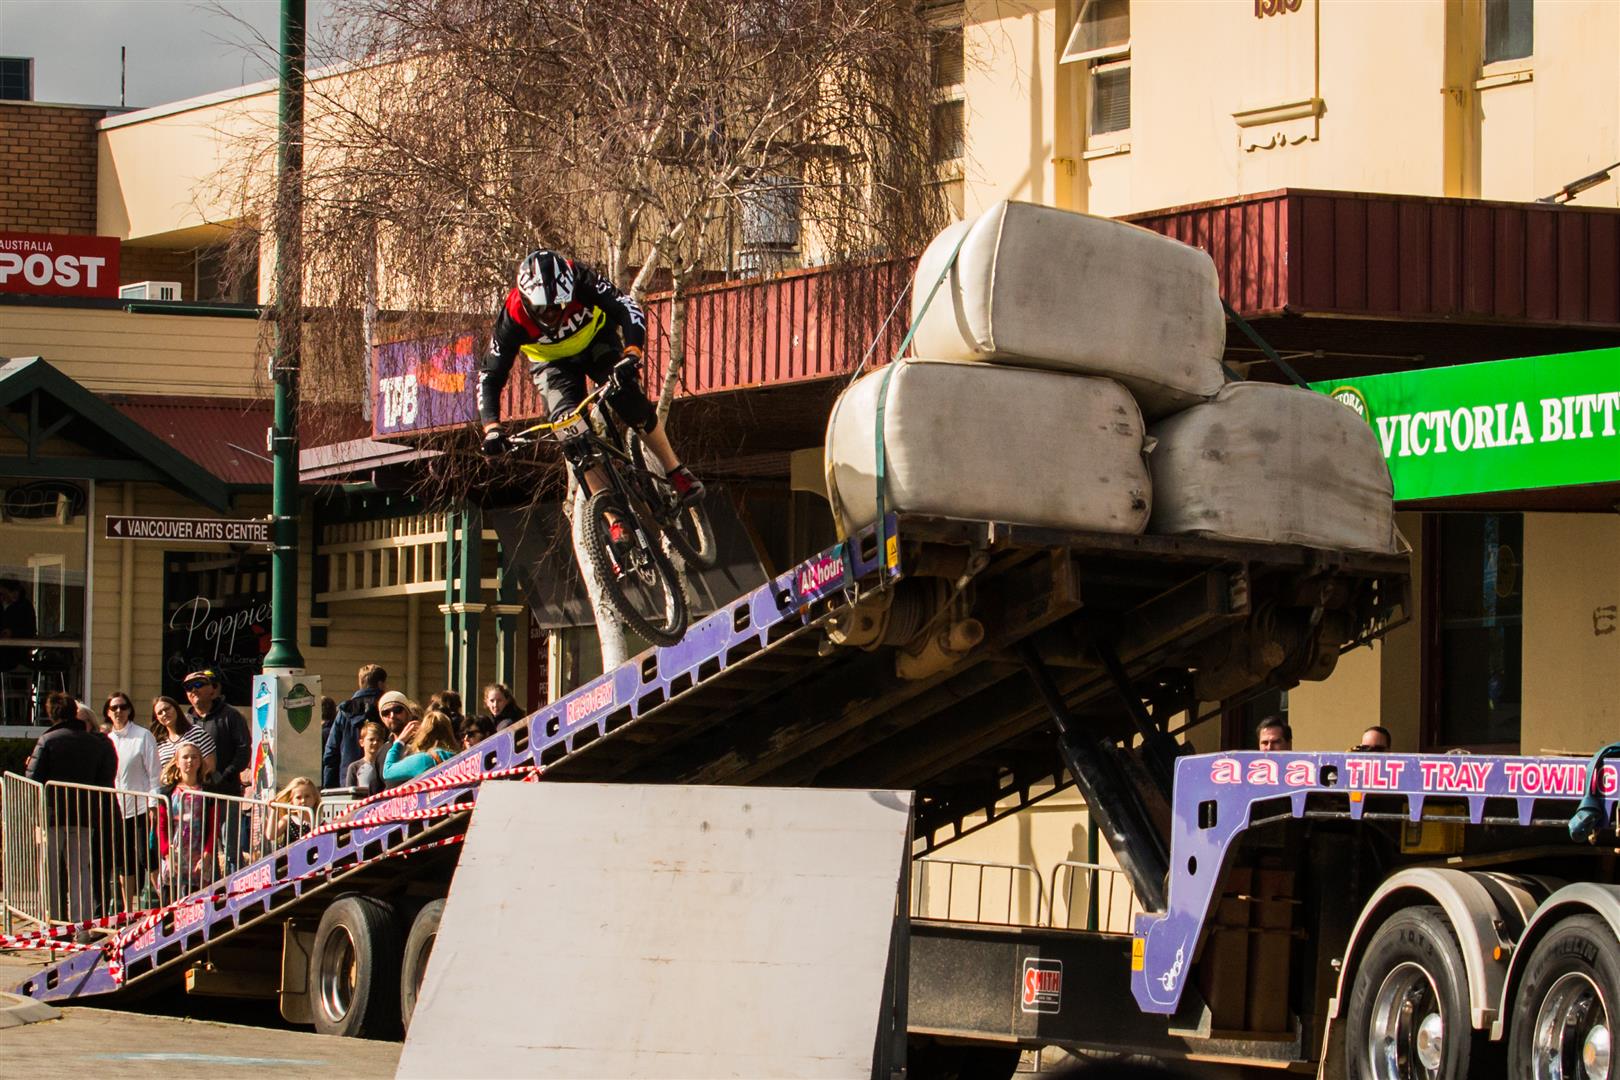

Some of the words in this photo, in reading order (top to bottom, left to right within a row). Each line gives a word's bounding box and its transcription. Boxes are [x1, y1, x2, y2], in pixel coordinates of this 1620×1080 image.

[0, 239, 54, 252] AUSTRALIA
[0, 252, 106, 288] POST
[1333, 392, 1364, 416] TORIA
[1375, 401, 1534, 458] VICTORIA
[1540, 391, 1620, 443] BITT
[127, 520, 193, 538] VANCOUVER
[194, 522, 224, 539] ARTS
[225, 523, 269, 541] CENTRE
[566, 680, 614, 727] RECOVERY
[1345, 758, 1405, 790] TILT
[1420, 760, 1494, 792] TRAY
[1504, 763, 1619, 796] TOWING
[1023, 967, 1061, 1004] SMITH
